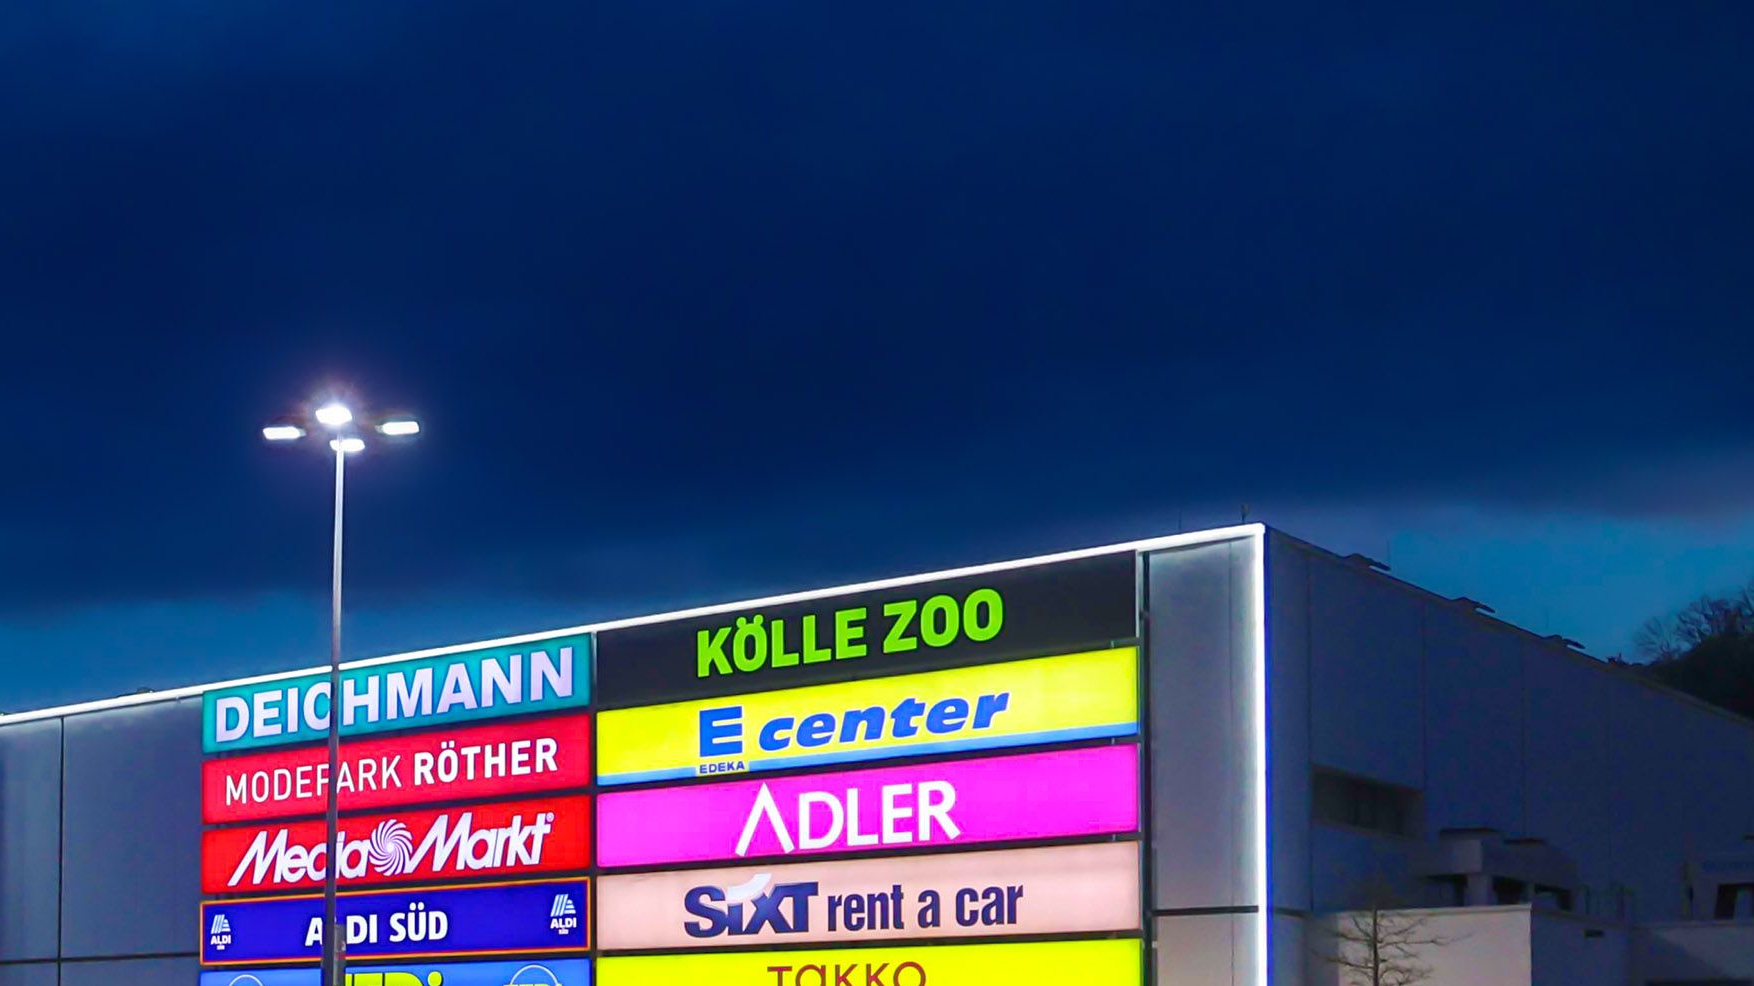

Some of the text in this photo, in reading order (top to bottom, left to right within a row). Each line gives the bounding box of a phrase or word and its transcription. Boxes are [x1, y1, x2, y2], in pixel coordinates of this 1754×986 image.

[697, 588, 1004, 677] KÖLLE ZOO
[215, 647, 573, 742] DEICHMANN
[699, 692, 1010, 757] E center
[226, 738, 558, 806] MODEPARK RÖTHER
[699, 761, 745, 774] EDEKA
[734, 780, 962, 857] ADLER
[305, 902, 448, 946] ADI SÜD
[550, 917, 577, 929] ALDI
[828, 885, 903, 931] rent
[917, 890, 940, 926] a
[955, 885, 1024, 924] car
[210, 934, 232, 945] ALDI
